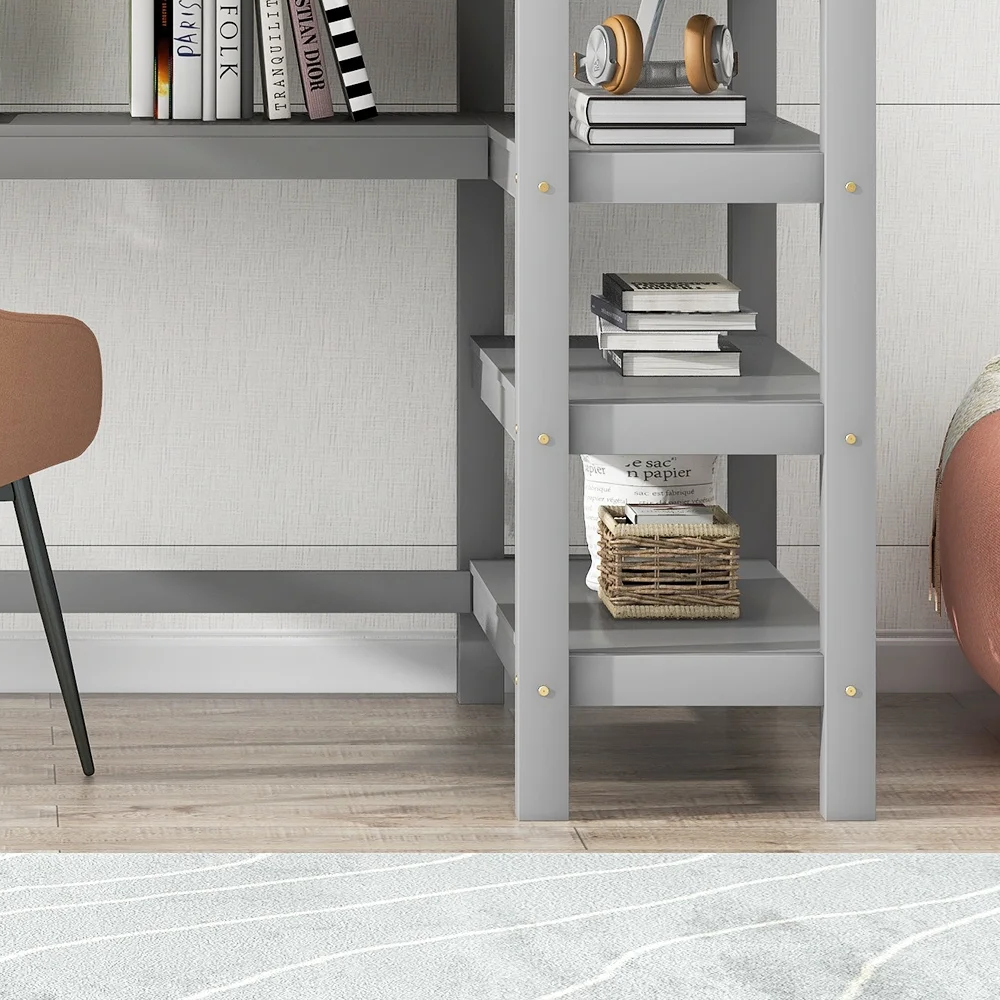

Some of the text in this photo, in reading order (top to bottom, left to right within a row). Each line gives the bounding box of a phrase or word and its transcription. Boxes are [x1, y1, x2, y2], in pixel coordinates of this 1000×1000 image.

[303, 48, 325, 92] DIOR
[645, 460, 672, 468] sac
[644, 467, 692, 482] papier
[665, 489, 695, 497] fabriqué
